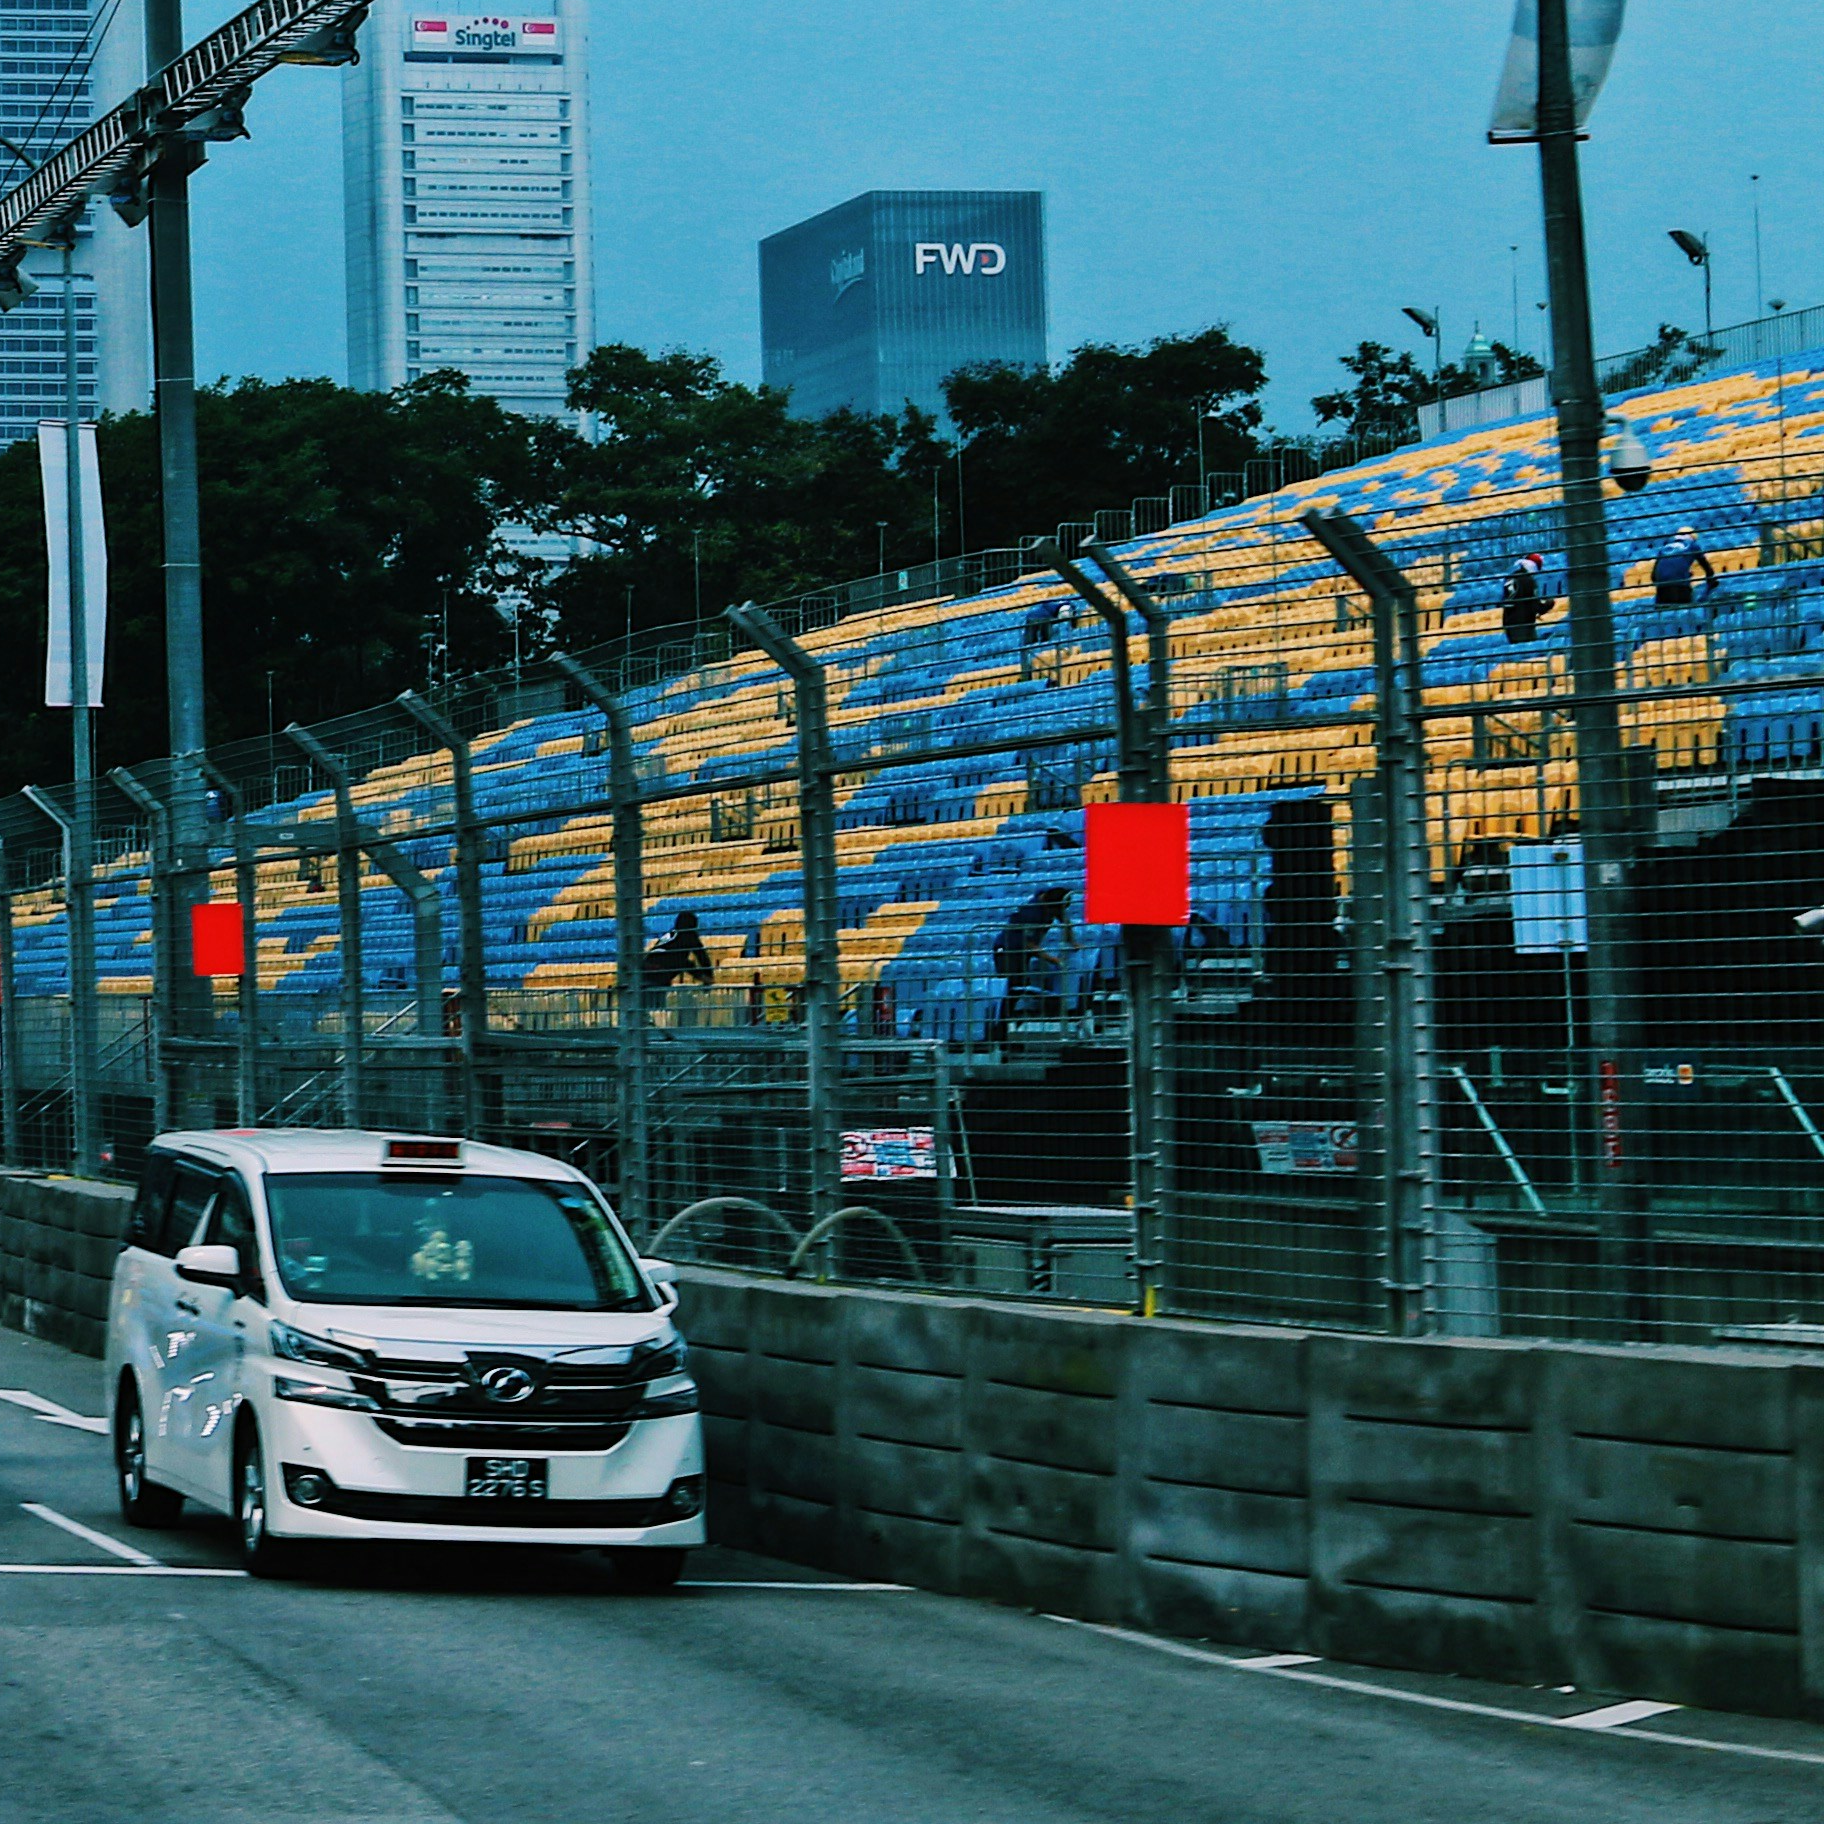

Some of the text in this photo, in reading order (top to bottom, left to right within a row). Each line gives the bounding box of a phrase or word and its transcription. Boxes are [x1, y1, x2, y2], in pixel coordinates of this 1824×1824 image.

[455, 29, 516, 51] Singtel
[915, 243, 1006, 275] FWD
[484, 1459, 529, 1477] SHD
[469, 1479, 545, 1498] 2276S
